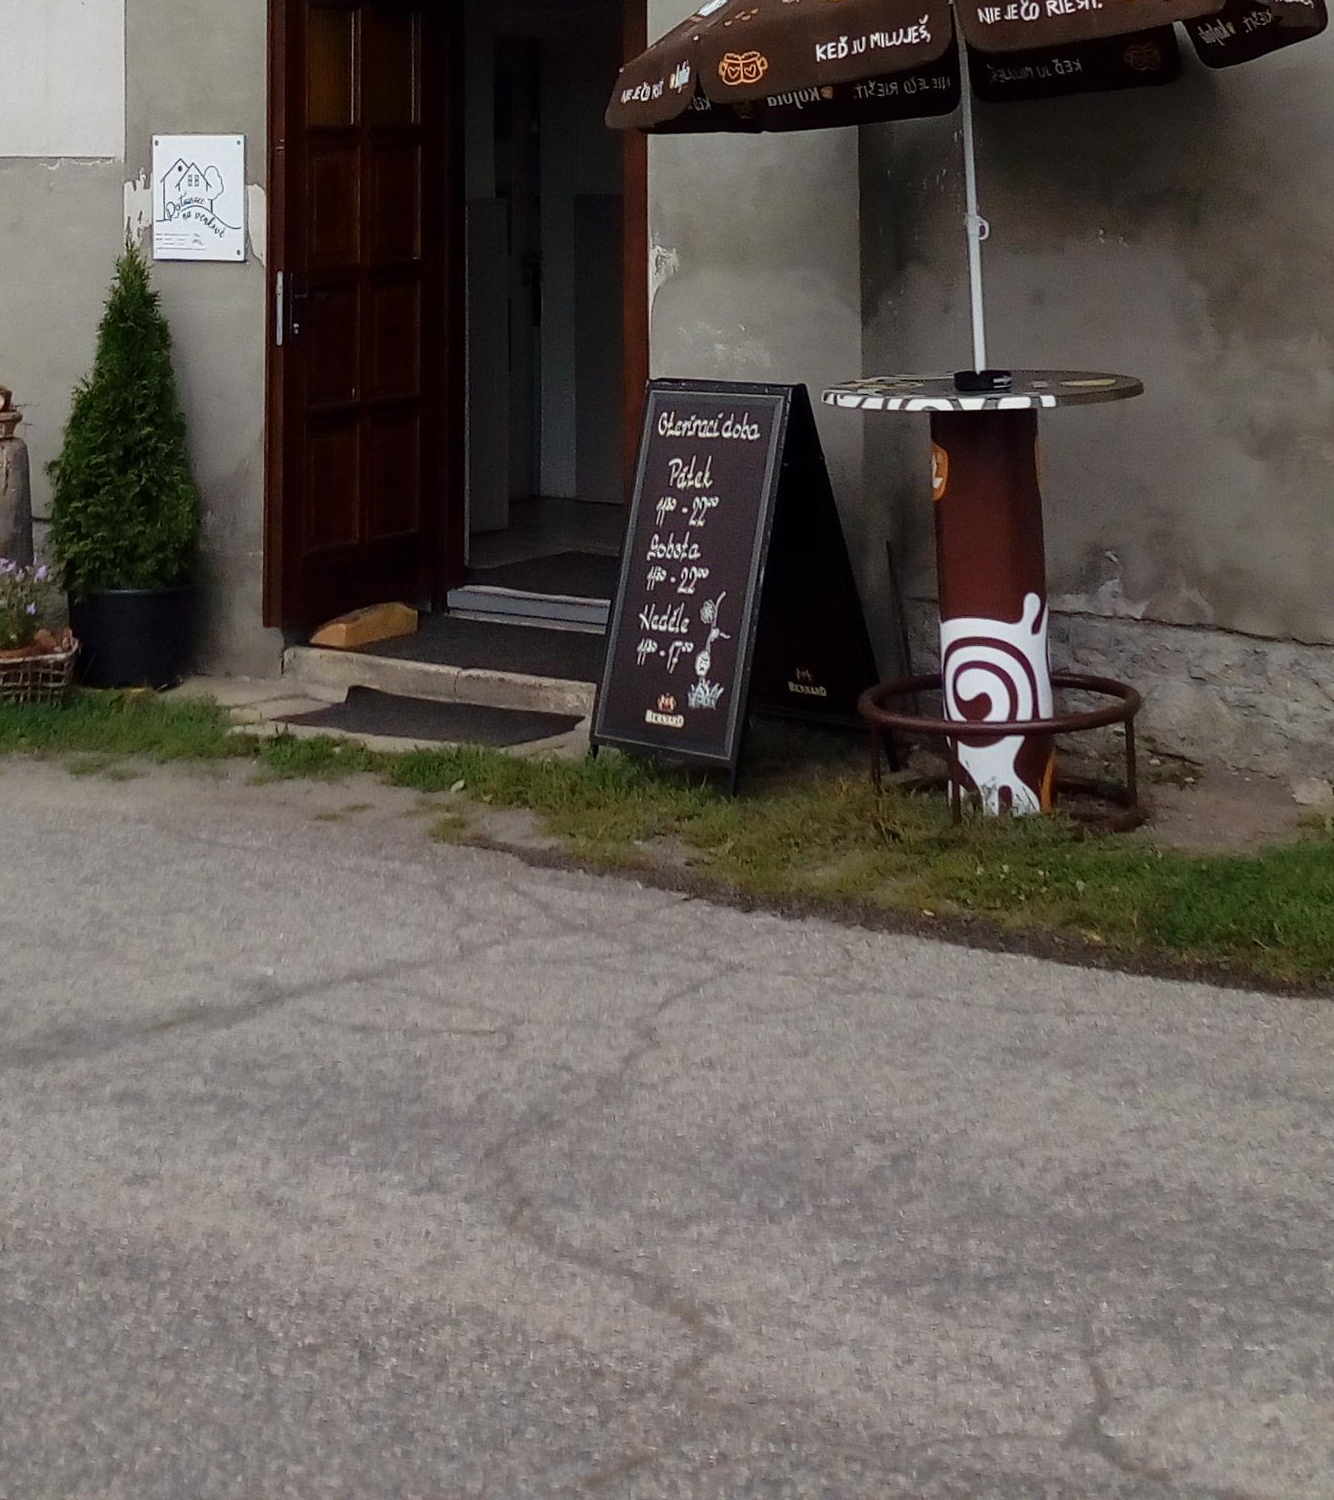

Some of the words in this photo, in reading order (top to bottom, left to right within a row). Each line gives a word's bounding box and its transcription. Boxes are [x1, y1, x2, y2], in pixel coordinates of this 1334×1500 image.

[977, 7, 1001, 25] NIE
[1004, 3, 1019, 20] JE
[815, 36, 848, 62] KEĎ
[851, 36, 867, 54] JU
[721, 412, 760, 440] doba
[668, 455, 713, 489] Pátek
[639, 602, 690, 633] Neděle
